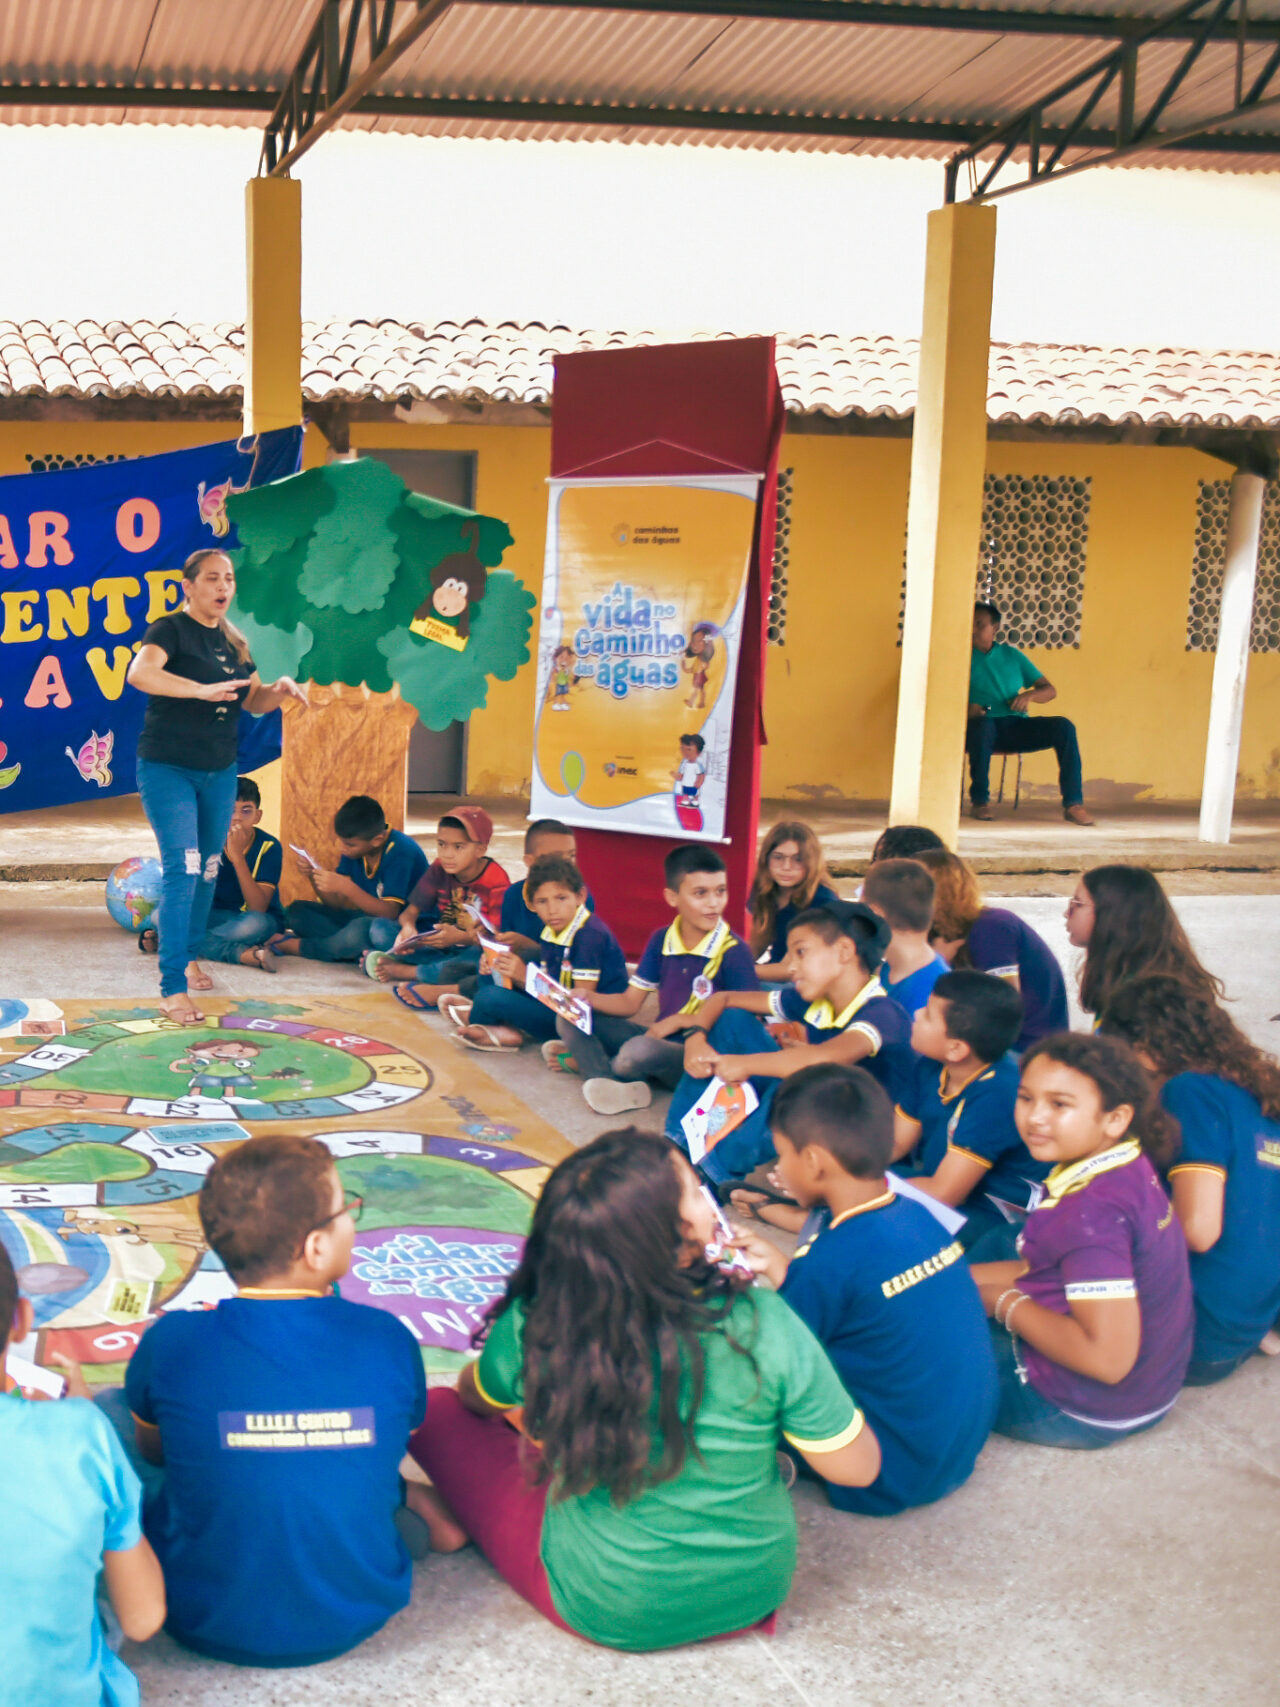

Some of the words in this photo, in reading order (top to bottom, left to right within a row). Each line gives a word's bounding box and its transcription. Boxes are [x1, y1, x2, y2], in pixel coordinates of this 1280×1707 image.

[115, 497, 161, 553] O
[653, 604, 676, 617] no
[574, 618, 686, 657] Caminho
[25, 655, 72, 709] A
[574, 658, 594, 677] das
[595, 654, 680, 699] águas
[323, 1034, 370, 1048] 26
[31, 1049, 76, 1063] 30
[379, 1065, 422, 1076] 25
[353, 1089, 402, 1104] 24
[151, 1145, 202, 1159] 16
[459, 1147, 497, 1160] 3
[10, 1186, 52, 1204] 14
[135, 1177, 183, 1197] 15
[352, 1255, 520, 1281] Caminh
[368, 1280, 414, 1296] das
[413, 1277, 508, 1305] águ
